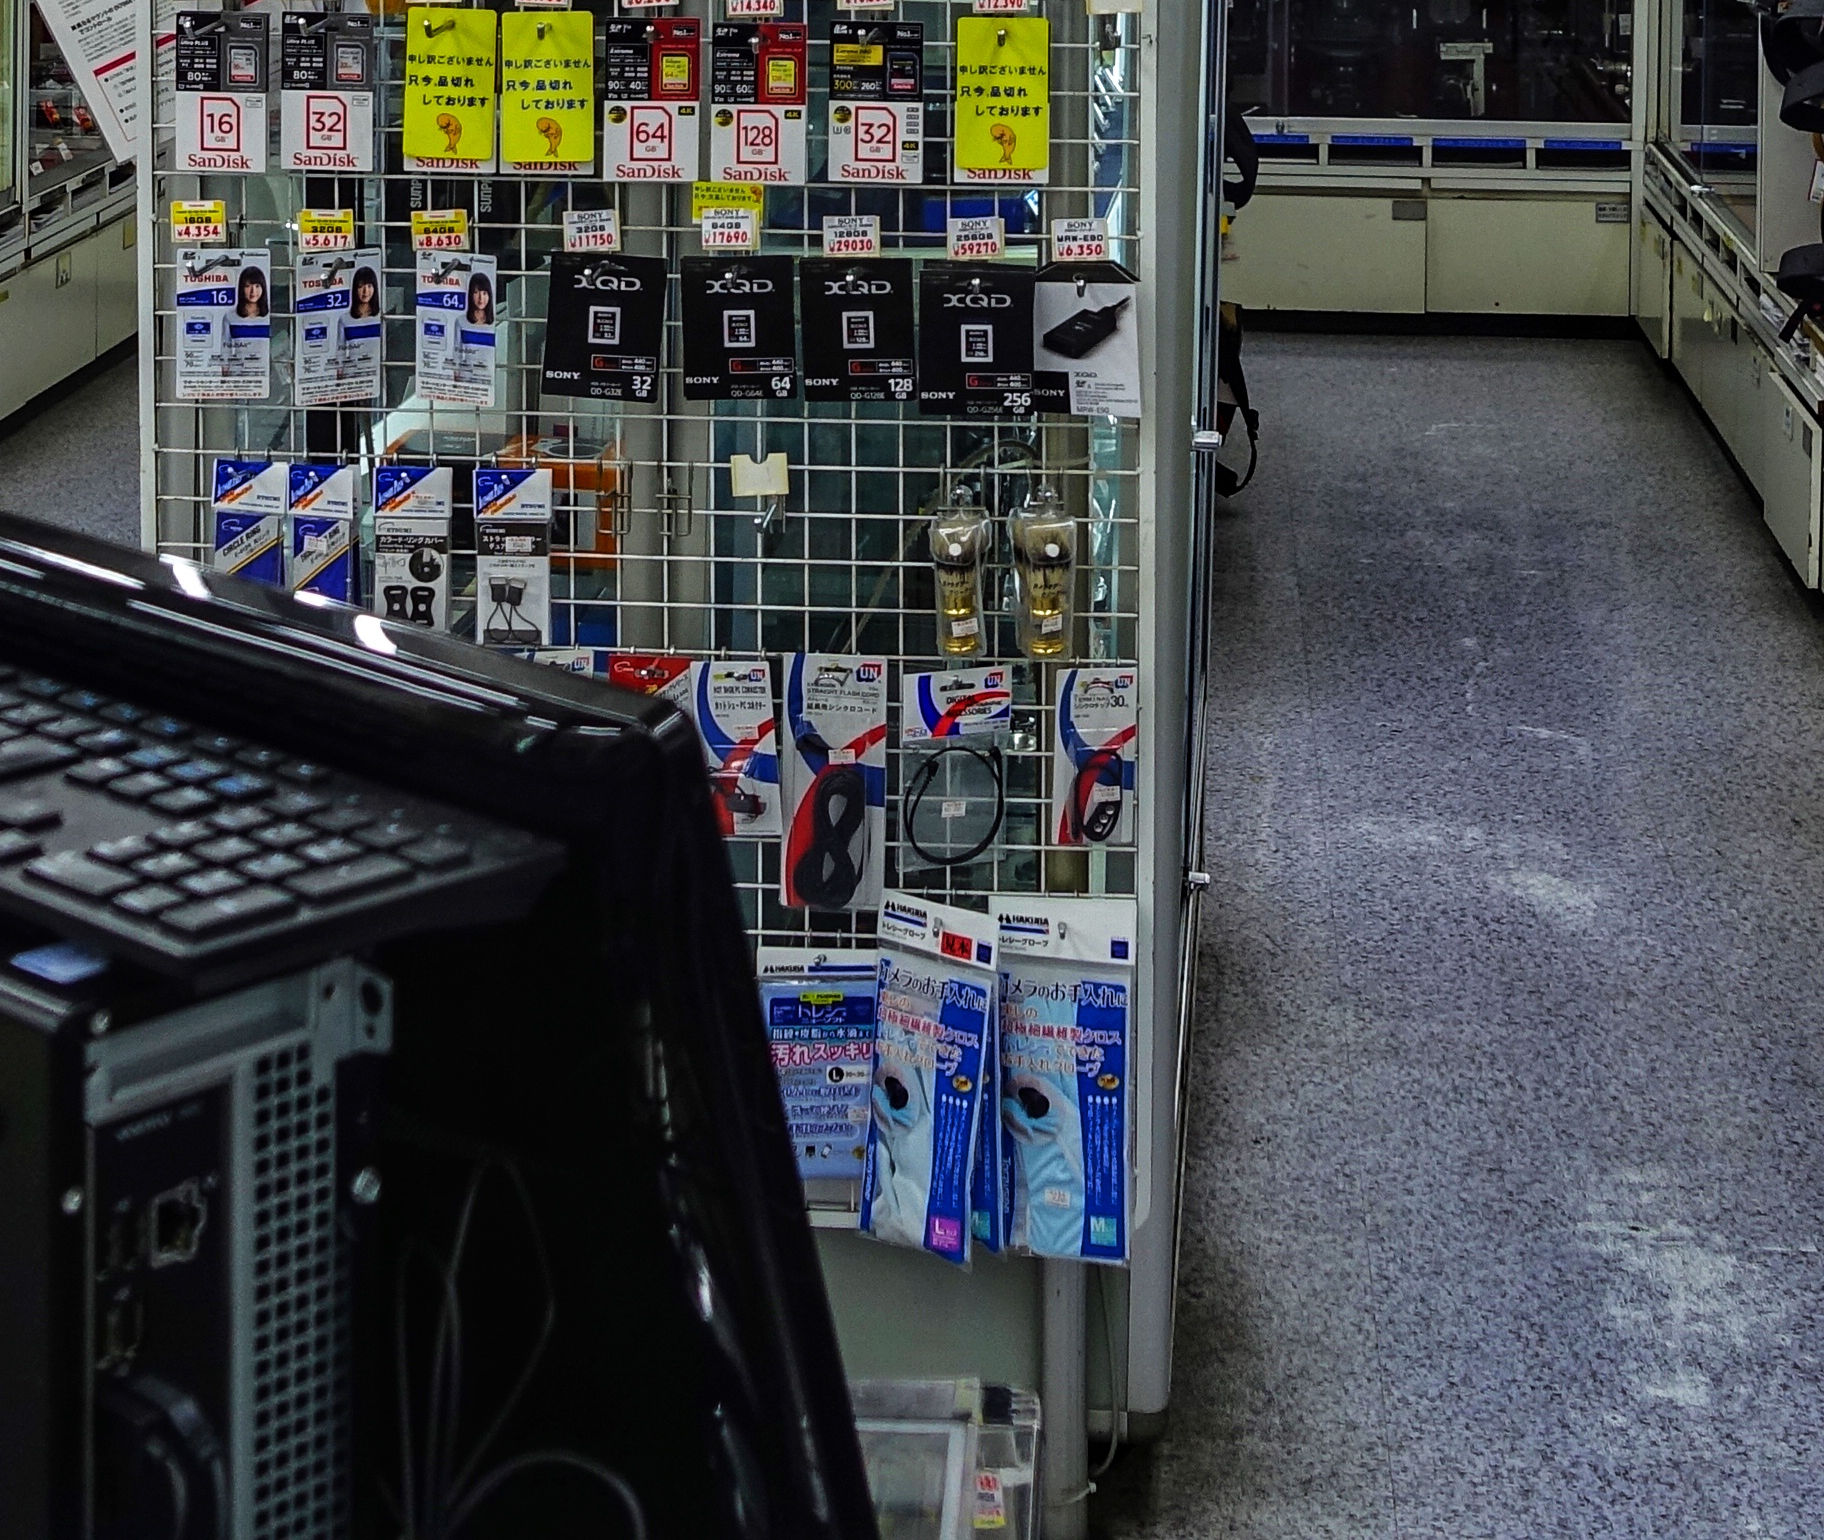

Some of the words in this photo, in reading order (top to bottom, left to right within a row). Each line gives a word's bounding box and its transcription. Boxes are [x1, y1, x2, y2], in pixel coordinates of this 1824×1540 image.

[407, 53, 494, 68] 申し訳ございません
[422, 94, 490, 108] しております
[520, 97, 589, 111] しております
[975, 105, 1044, 118] しております
[205, 112, 234, 133] 16
[311, 111, 343, 133] 32
[635, 122, 668, 144] 64
[741, 125, 774, 148] 128
[859, 121, 893, 145] 32
[187, 152, 252, 170] SanDisk
[292, 151, 358, 169] SanDisk
[616, 164, 684, 180] SanDisk
[722, 165, 790, 183] SanDisk
[545, 370, 581, 380] SONY
[685, 376, 720, 384] SONY
[805, 378, 840, 387] SONY
[920, 391, 956, 400] SONY
[1002, 392, 1032, 407] 256
[943, 935, 971, 956] 見本
